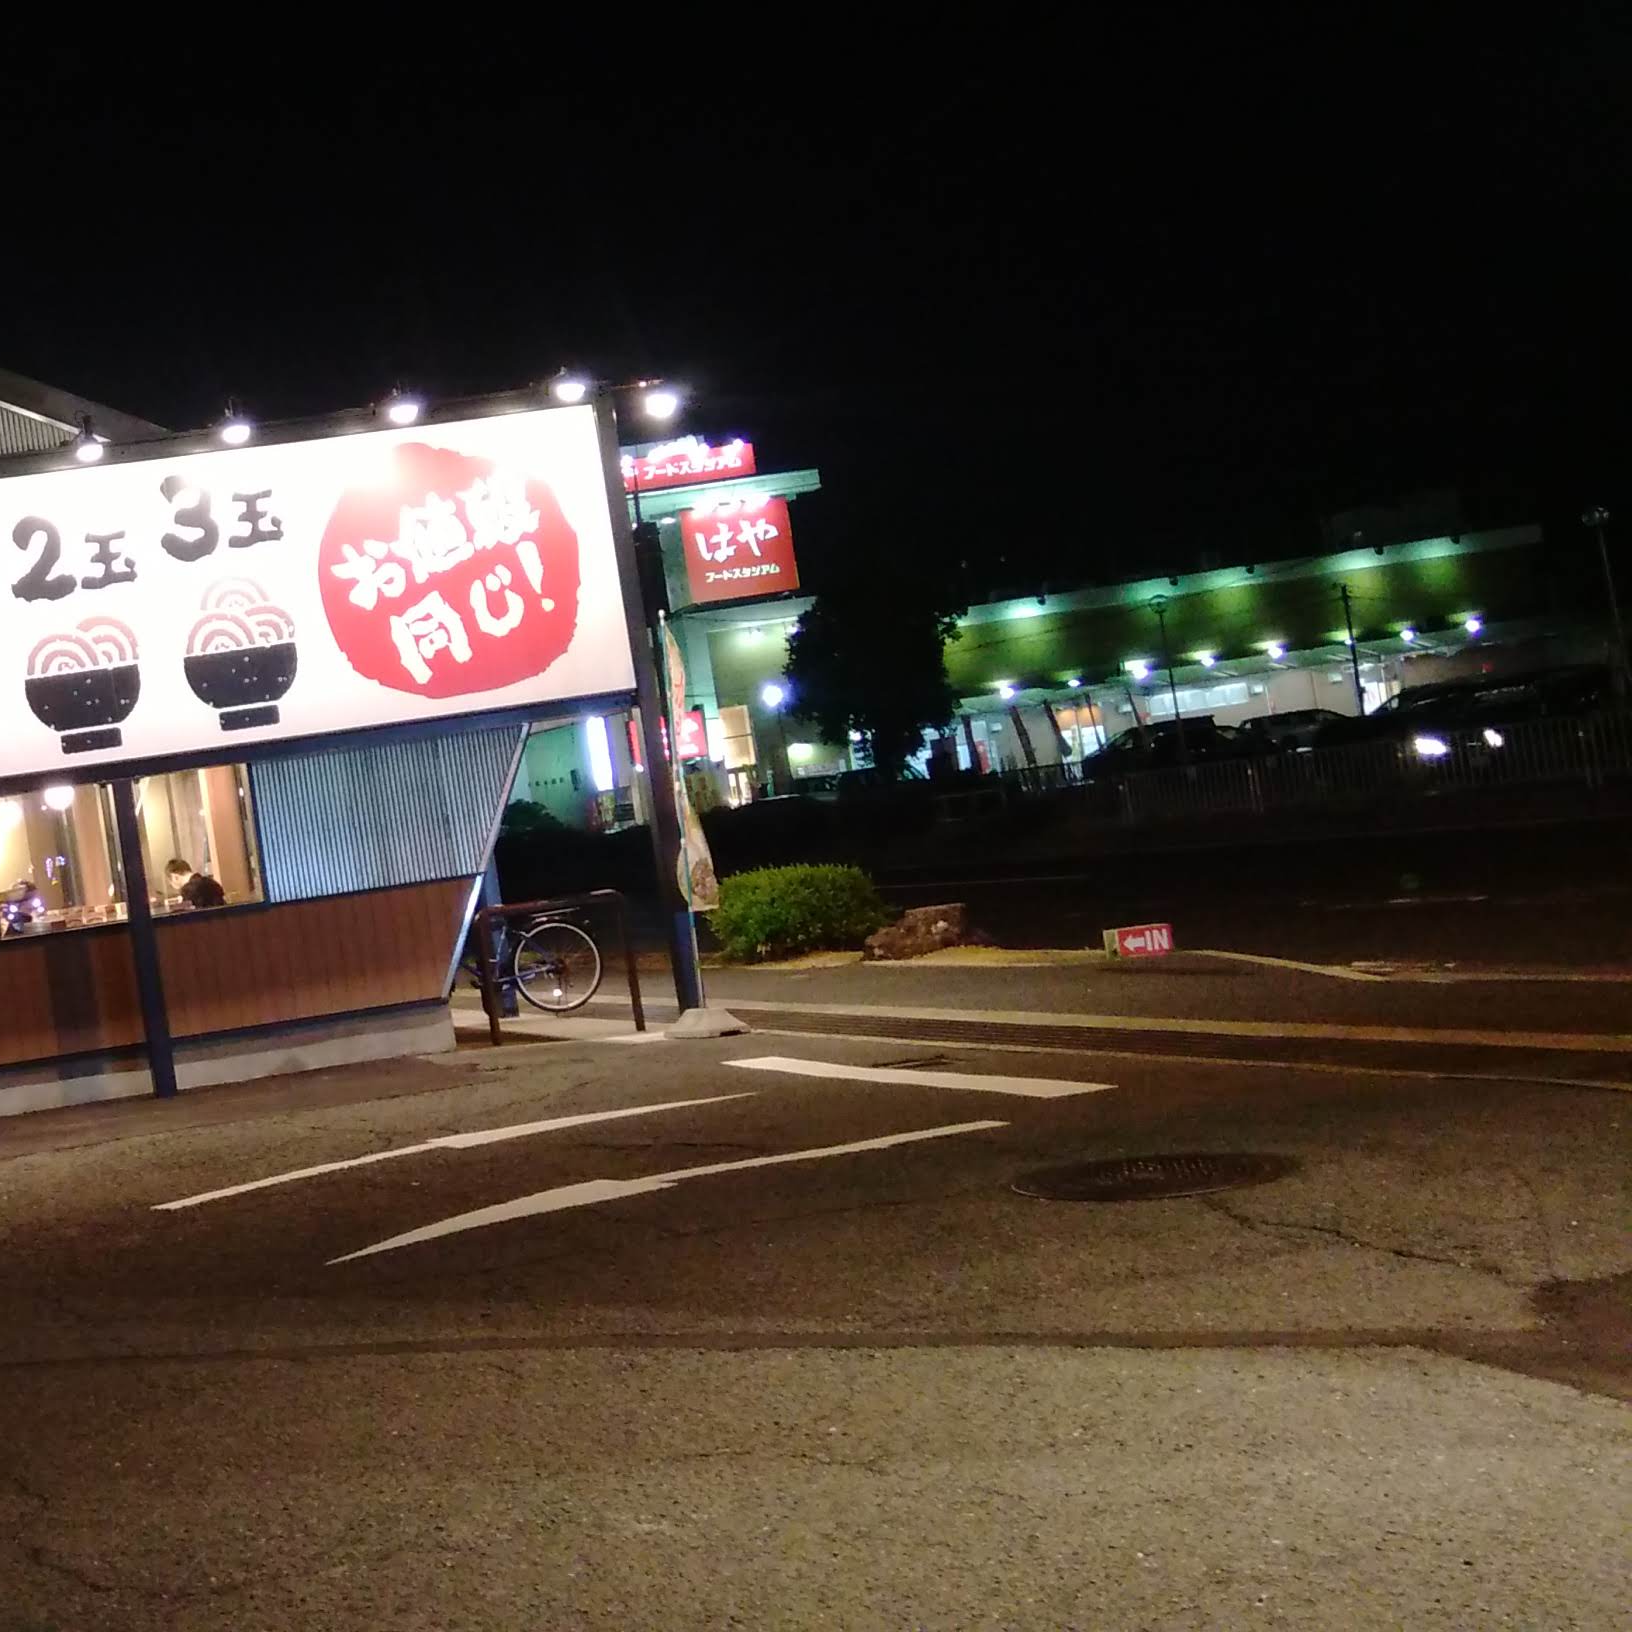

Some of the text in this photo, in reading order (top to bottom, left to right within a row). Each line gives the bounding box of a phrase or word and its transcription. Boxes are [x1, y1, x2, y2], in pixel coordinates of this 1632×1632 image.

[160, 474, 284, 562] 3玉
[12, 515, 137, 602] 2玉
[705, 563, 780, 583] フードスタジアム
[1144, 928, 1170, 952] IN
